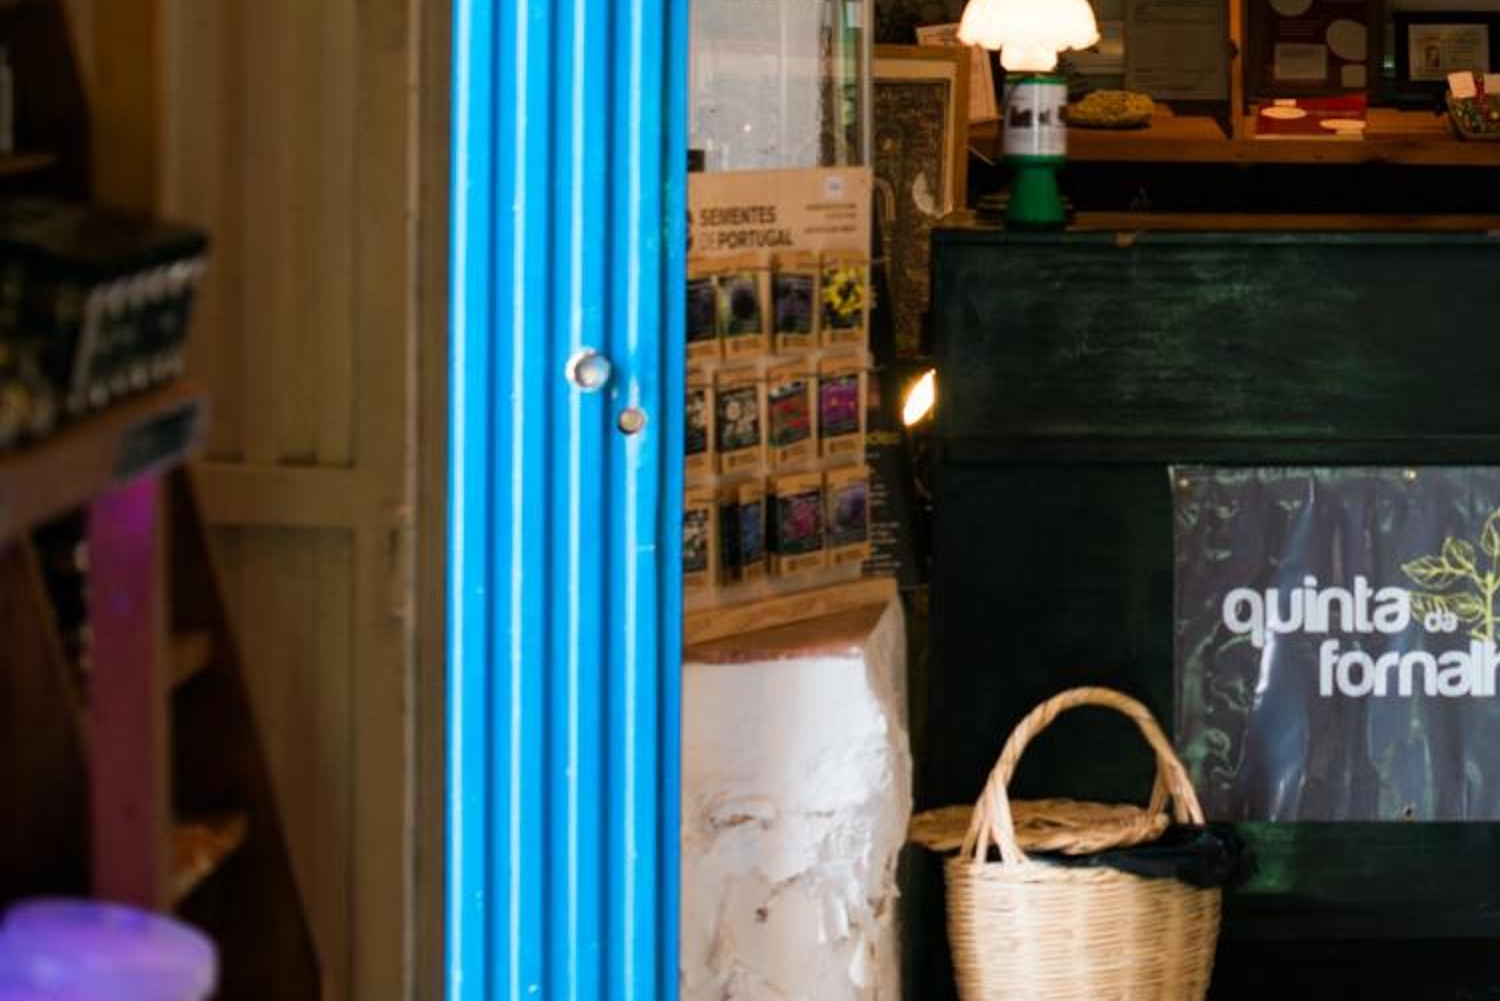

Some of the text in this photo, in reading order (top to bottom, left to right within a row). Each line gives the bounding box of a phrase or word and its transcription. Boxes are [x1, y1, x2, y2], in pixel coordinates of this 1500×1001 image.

[717, 228, 794, 249] PORTUGAL
[1222, 575, 1458, 649] quinta da
